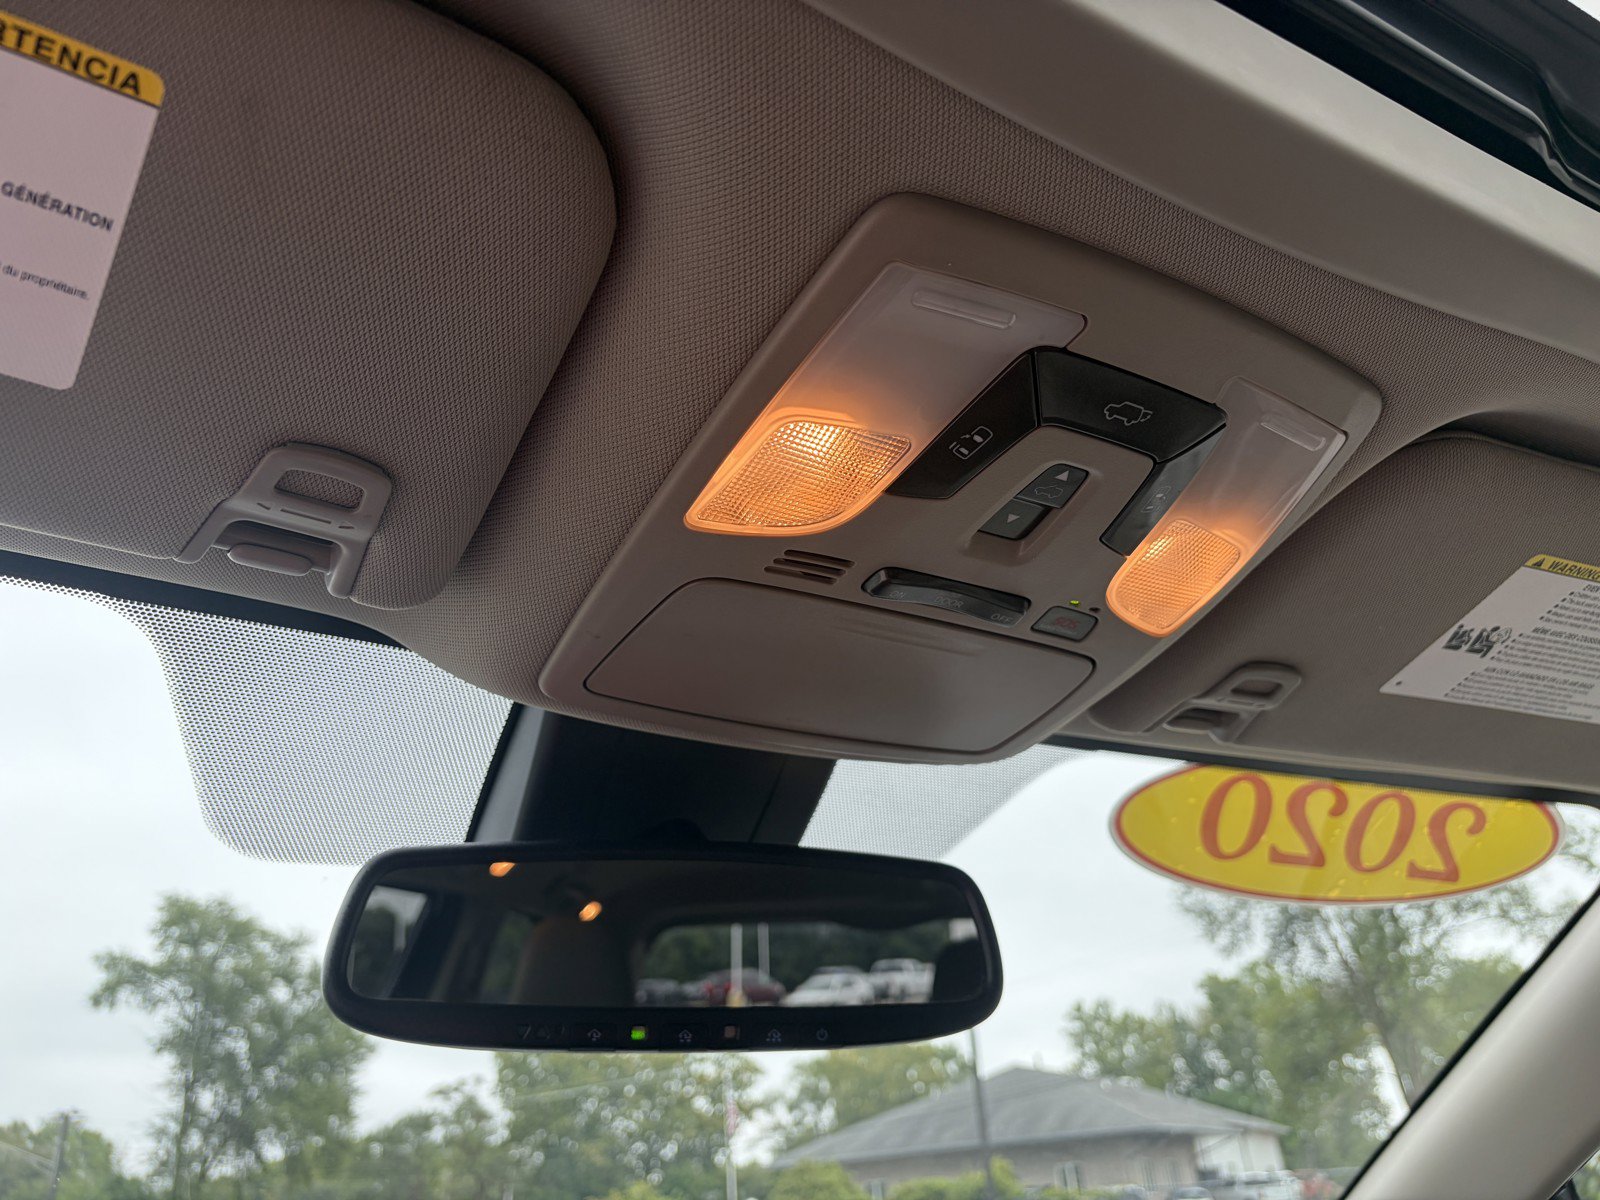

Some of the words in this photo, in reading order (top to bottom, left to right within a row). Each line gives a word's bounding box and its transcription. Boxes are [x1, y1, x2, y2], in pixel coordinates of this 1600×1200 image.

[1, 181, 114, 232] GÉNÉRATION
[889, 591, 906, 600] ON
[934, 596, 964, 609] DOOR
[990, 612, 1017, 624] OFF
